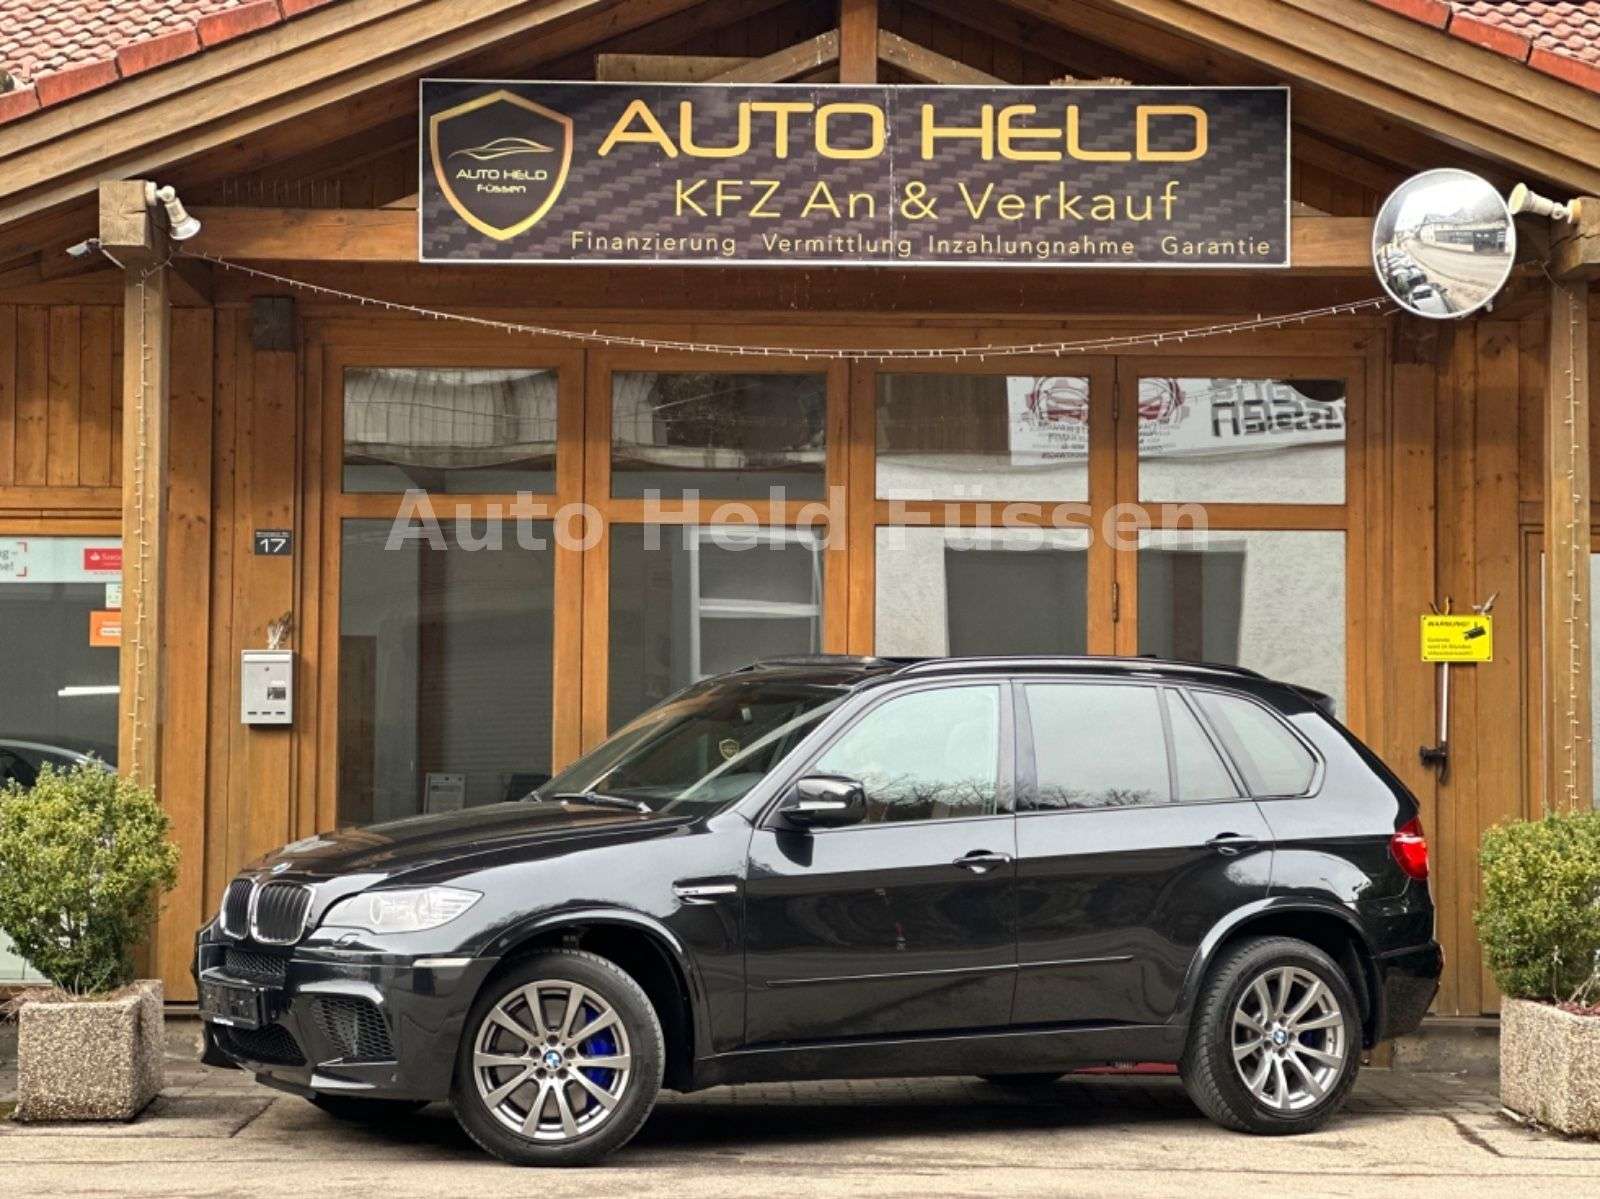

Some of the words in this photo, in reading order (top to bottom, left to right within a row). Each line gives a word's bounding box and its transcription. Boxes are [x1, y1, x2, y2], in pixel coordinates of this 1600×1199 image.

[598, 99, 886, 160] AUTO
[921, 103, 1208, 162] HELD
[456, 168, 500, 180] AUTO
[504, 168, 548, 181] HELD
[675, 179, 781, 218] KFZ
[801, 180, 876, 219] An
[900, 181, 939, 220] &
[958, 180, 1180, 221] Verkauf
[571, 230, 736, 256] Finanzierung
[762, 232, 912, 258] Vermittlung
[928, 234, 1136, 259] Inzahlungnahme
[1161, 236, 1271, 256] Garantie
[260, 538, 287, 553] 17
